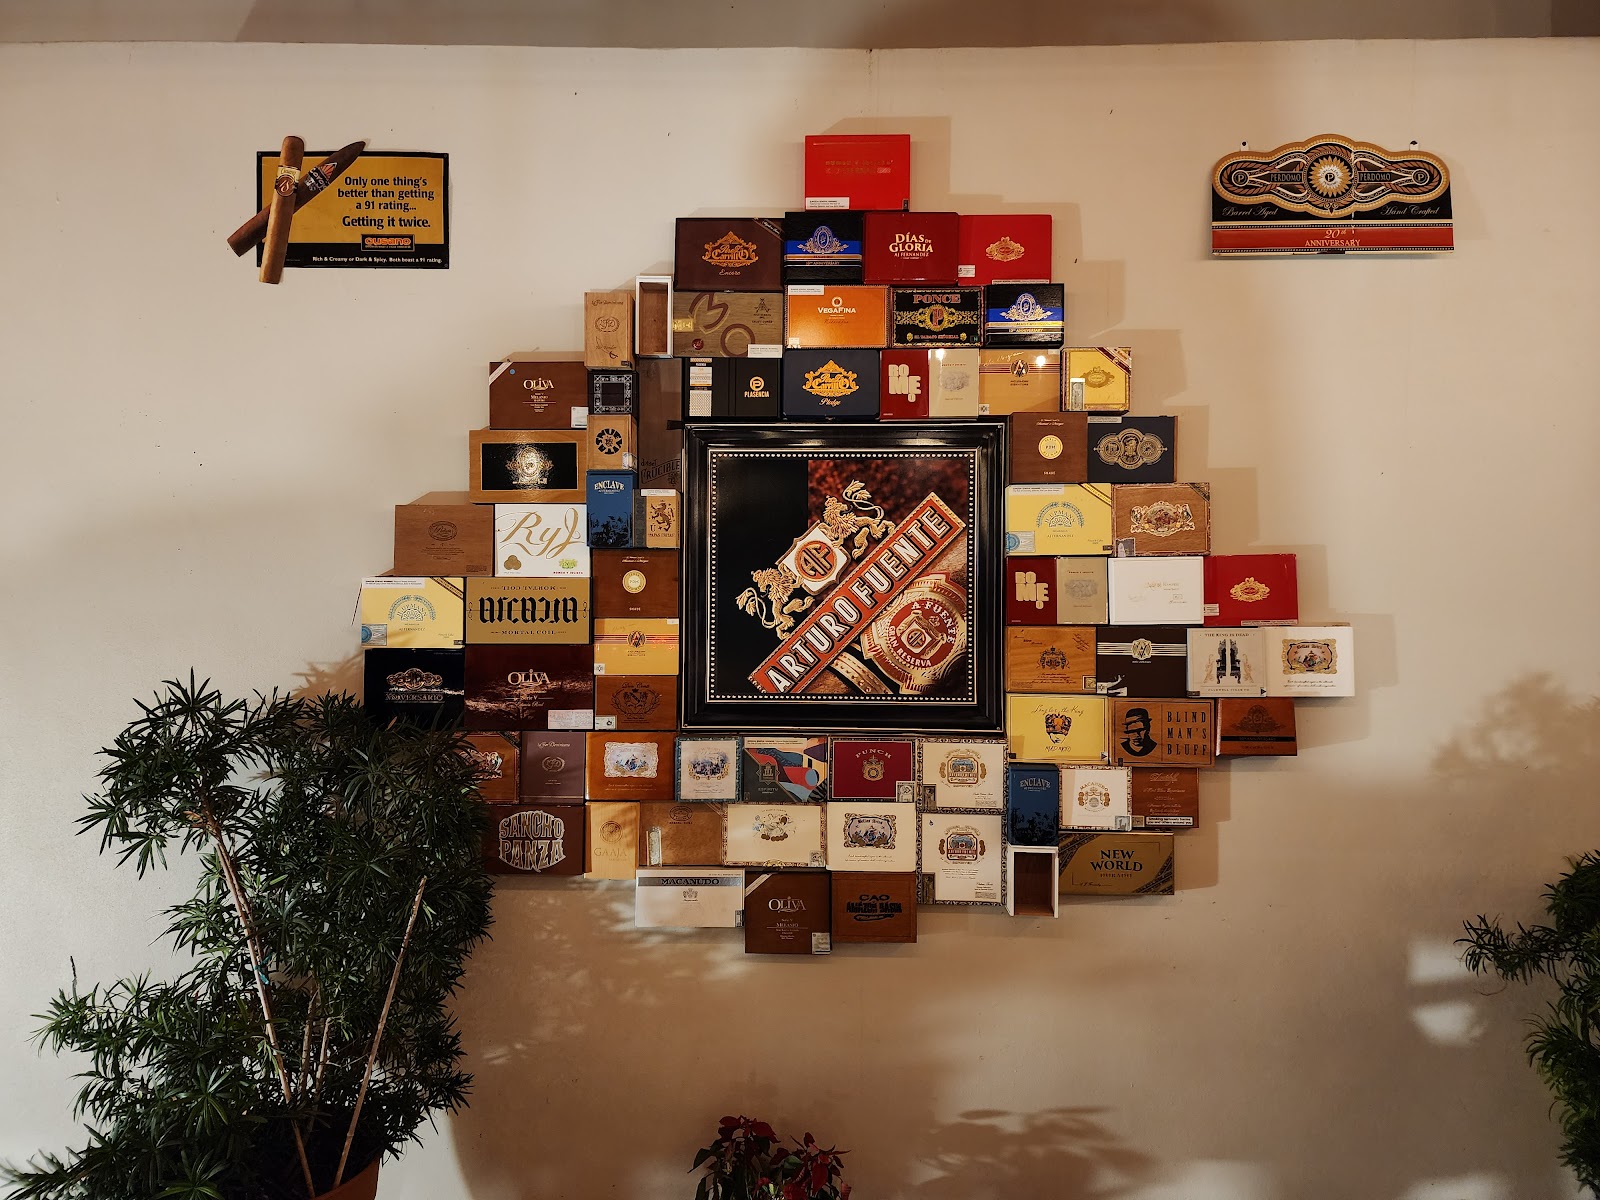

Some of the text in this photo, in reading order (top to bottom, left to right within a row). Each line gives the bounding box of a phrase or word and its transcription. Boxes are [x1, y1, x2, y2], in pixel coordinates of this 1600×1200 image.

[344, 176, 427, 188] Only one thing's
[1270, 173, 1302, 182] PERDOMO
[1360, 173, 1391, 181] PERDOMO
[337, 188, 434, 201] better than getting
[356, 201, 417, 212] a 91 rating...
[1222, 206, 1279, 219] Barrel Aged
[1380, 204, 1440, 216] Hand Crafted
[342, 216, 431, 230] Getting it twice.
[895, 231, 925, 243] DÍAS
[1305, 239, 1360, 247] ANNIVERSARY
[888, 243, 933, 252] GLORIA
[913, 294, 961, 304] PONCE
[523, 377, 555, 391] OLIVA
[641, 460, 680, 480] CRUCIBLE
[594, 480, 625, 490] ENCLAVE
[765, 506, 953, 693] ARTURO FUENTE
[888, 626, 932, 667] GRAN RESERVA
[507, 669, 550, 686] OLIVA
[1167, 711, 1206, 723] BLIND
[1167, 728, 1206, 739] MAN'S
[855, 749, 893, 760] PUNCH
[1167, 744, 1207, 755] BLUFF
[1020, 778, 1051, 789] ENCLAVE
[498, 810, 565, 840] SANCHO
[498, 839, 566, 873] PANZA
[1100, 850, 1134, 859] NEW
[1090, 861, 1143, 871] WORLD
[768, 896, 807, 913] OLIVA
